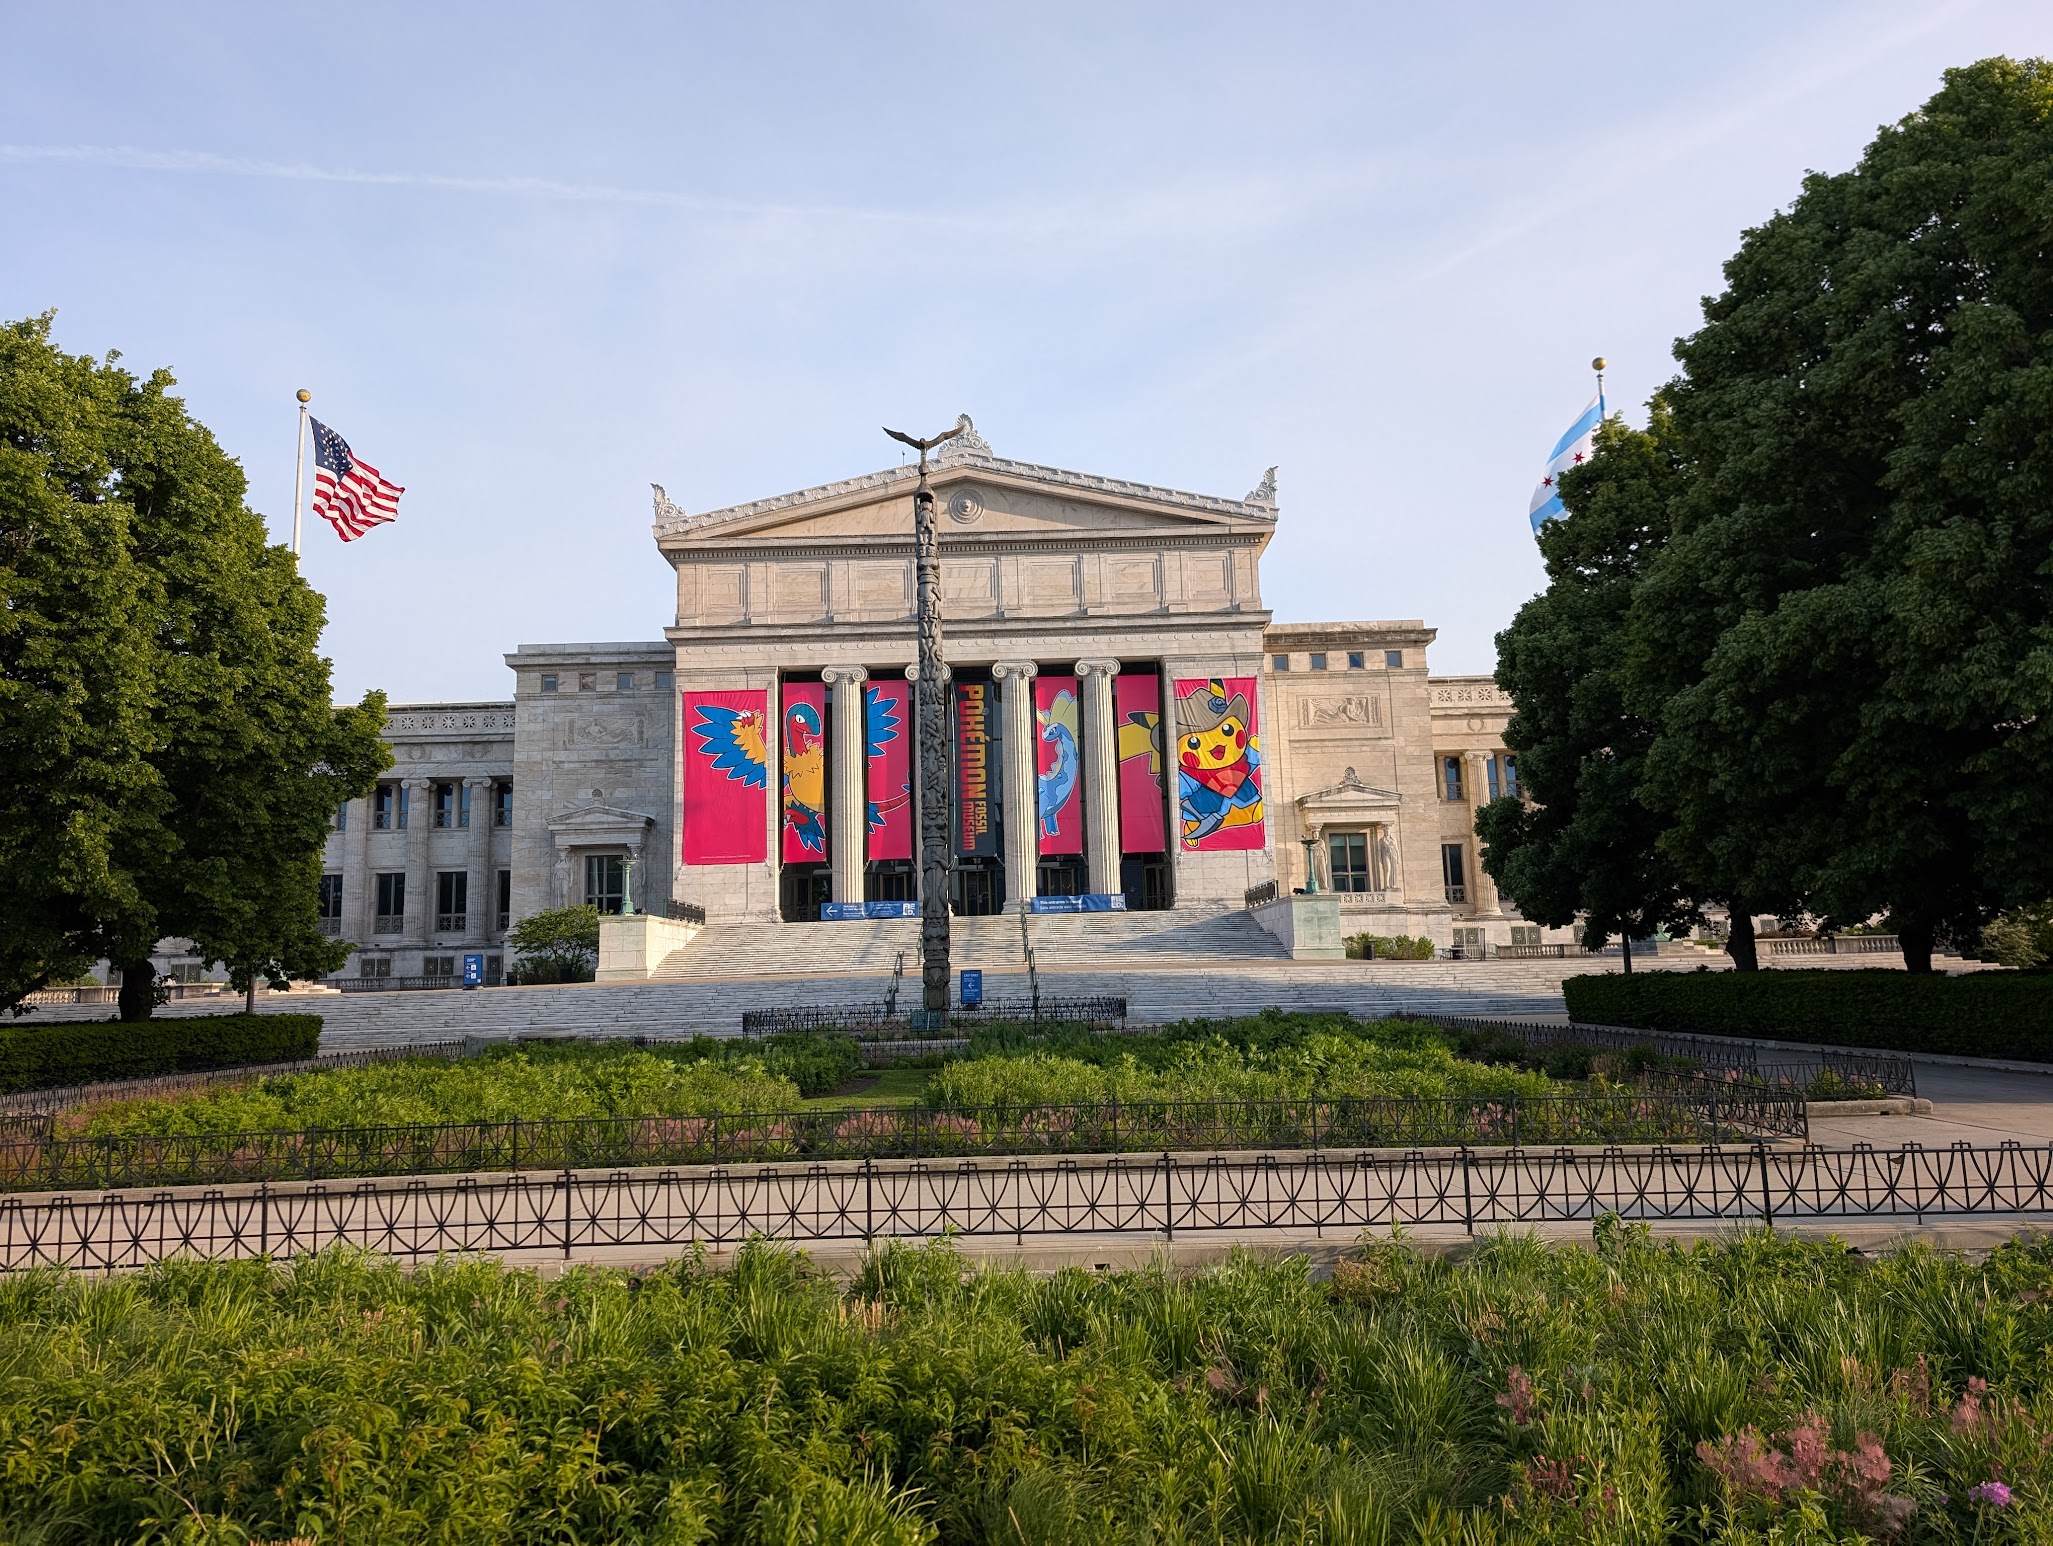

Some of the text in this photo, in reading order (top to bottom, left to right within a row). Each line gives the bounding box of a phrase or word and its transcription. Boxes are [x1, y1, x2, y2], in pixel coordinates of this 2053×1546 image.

[960, 685, 990, 799] POKÉMON
[963, 802, 976, 850] MUSEUM
[976, 802, 988, 835] FOSSIL
